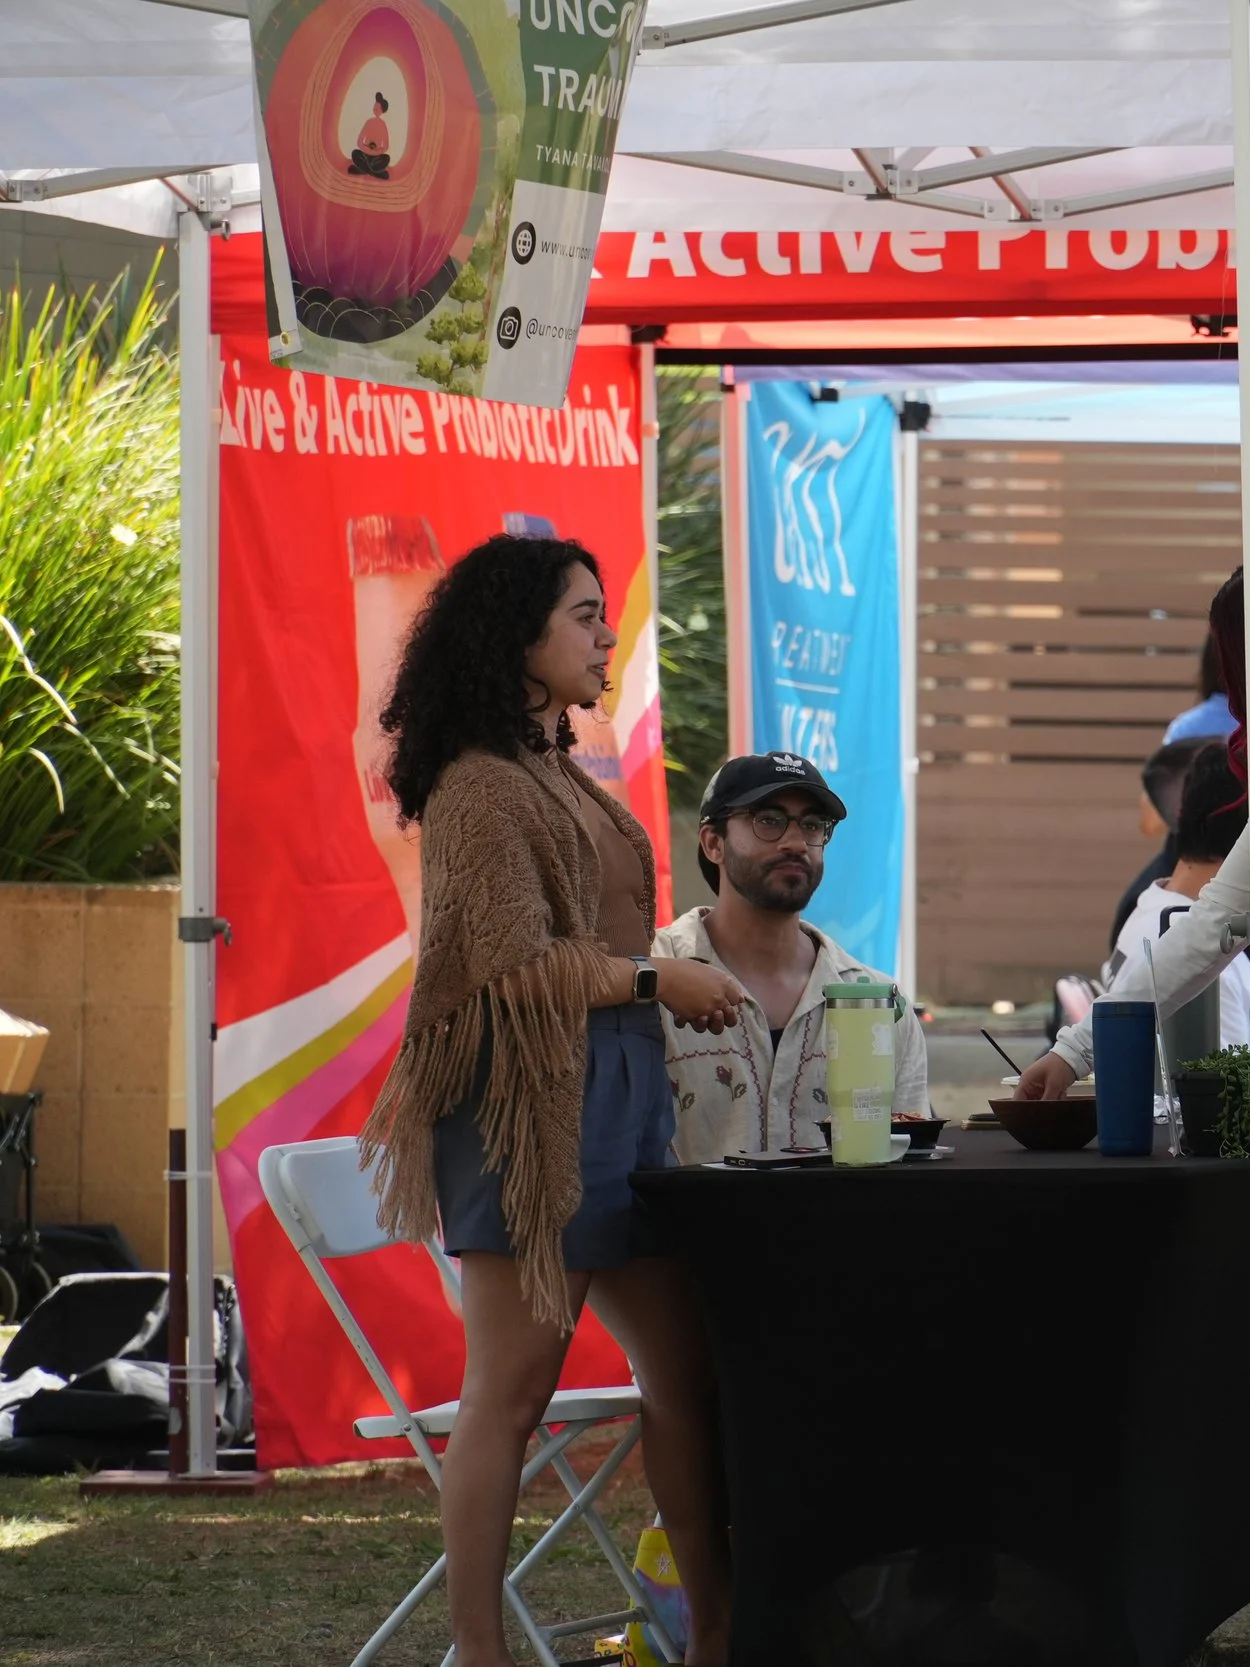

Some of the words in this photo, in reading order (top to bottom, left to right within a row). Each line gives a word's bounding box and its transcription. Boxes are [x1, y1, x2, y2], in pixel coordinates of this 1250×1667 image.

[536, 144, 578, 170] TYANA
[219, 359, 286, 453] Live
[289, 369, 319, 454] &
[324, 375, 427, 457] Active
[775, 765, 806, 776] adidas
